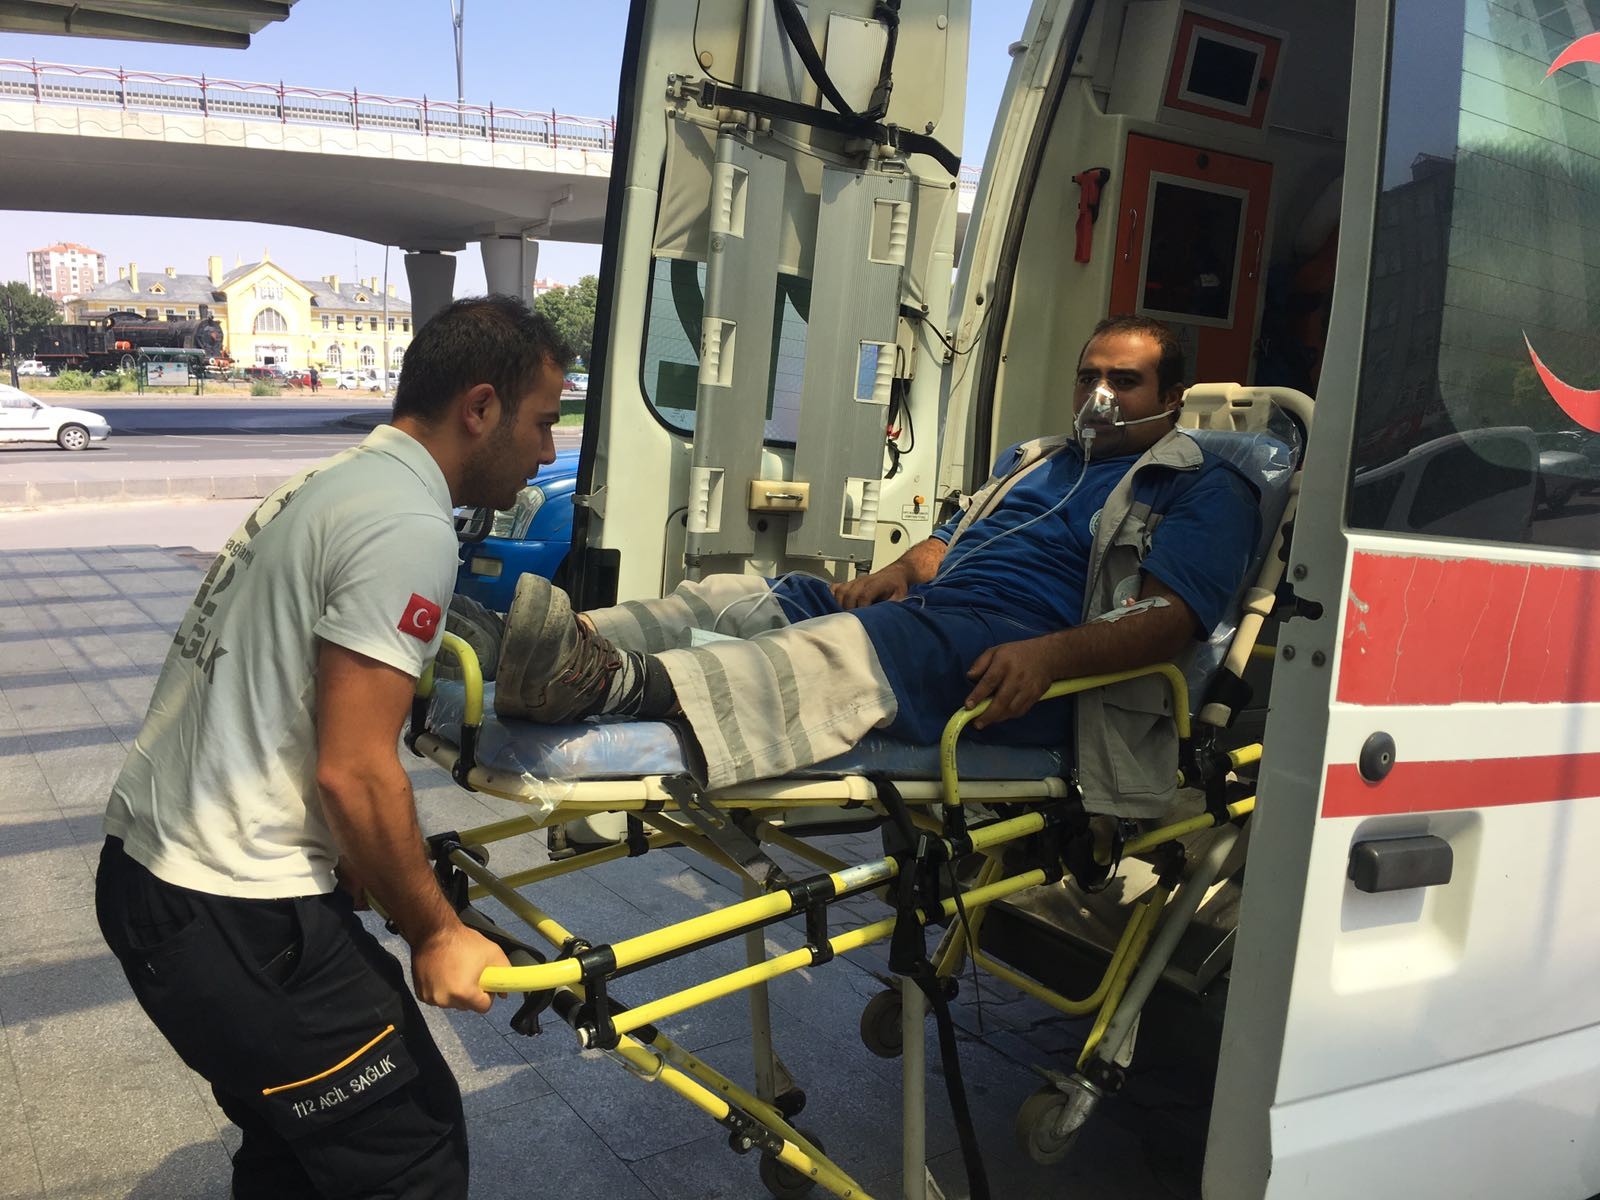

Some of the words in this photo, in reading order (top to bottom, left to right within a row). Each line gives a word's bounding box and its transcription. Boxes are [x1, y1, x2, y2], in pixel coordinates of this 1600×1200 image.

[292, 1099, 316, 1118] 112
[319, 1086, 349, 1110] ACİL
[349, 1055, 397, 1093] SAĞLIK
